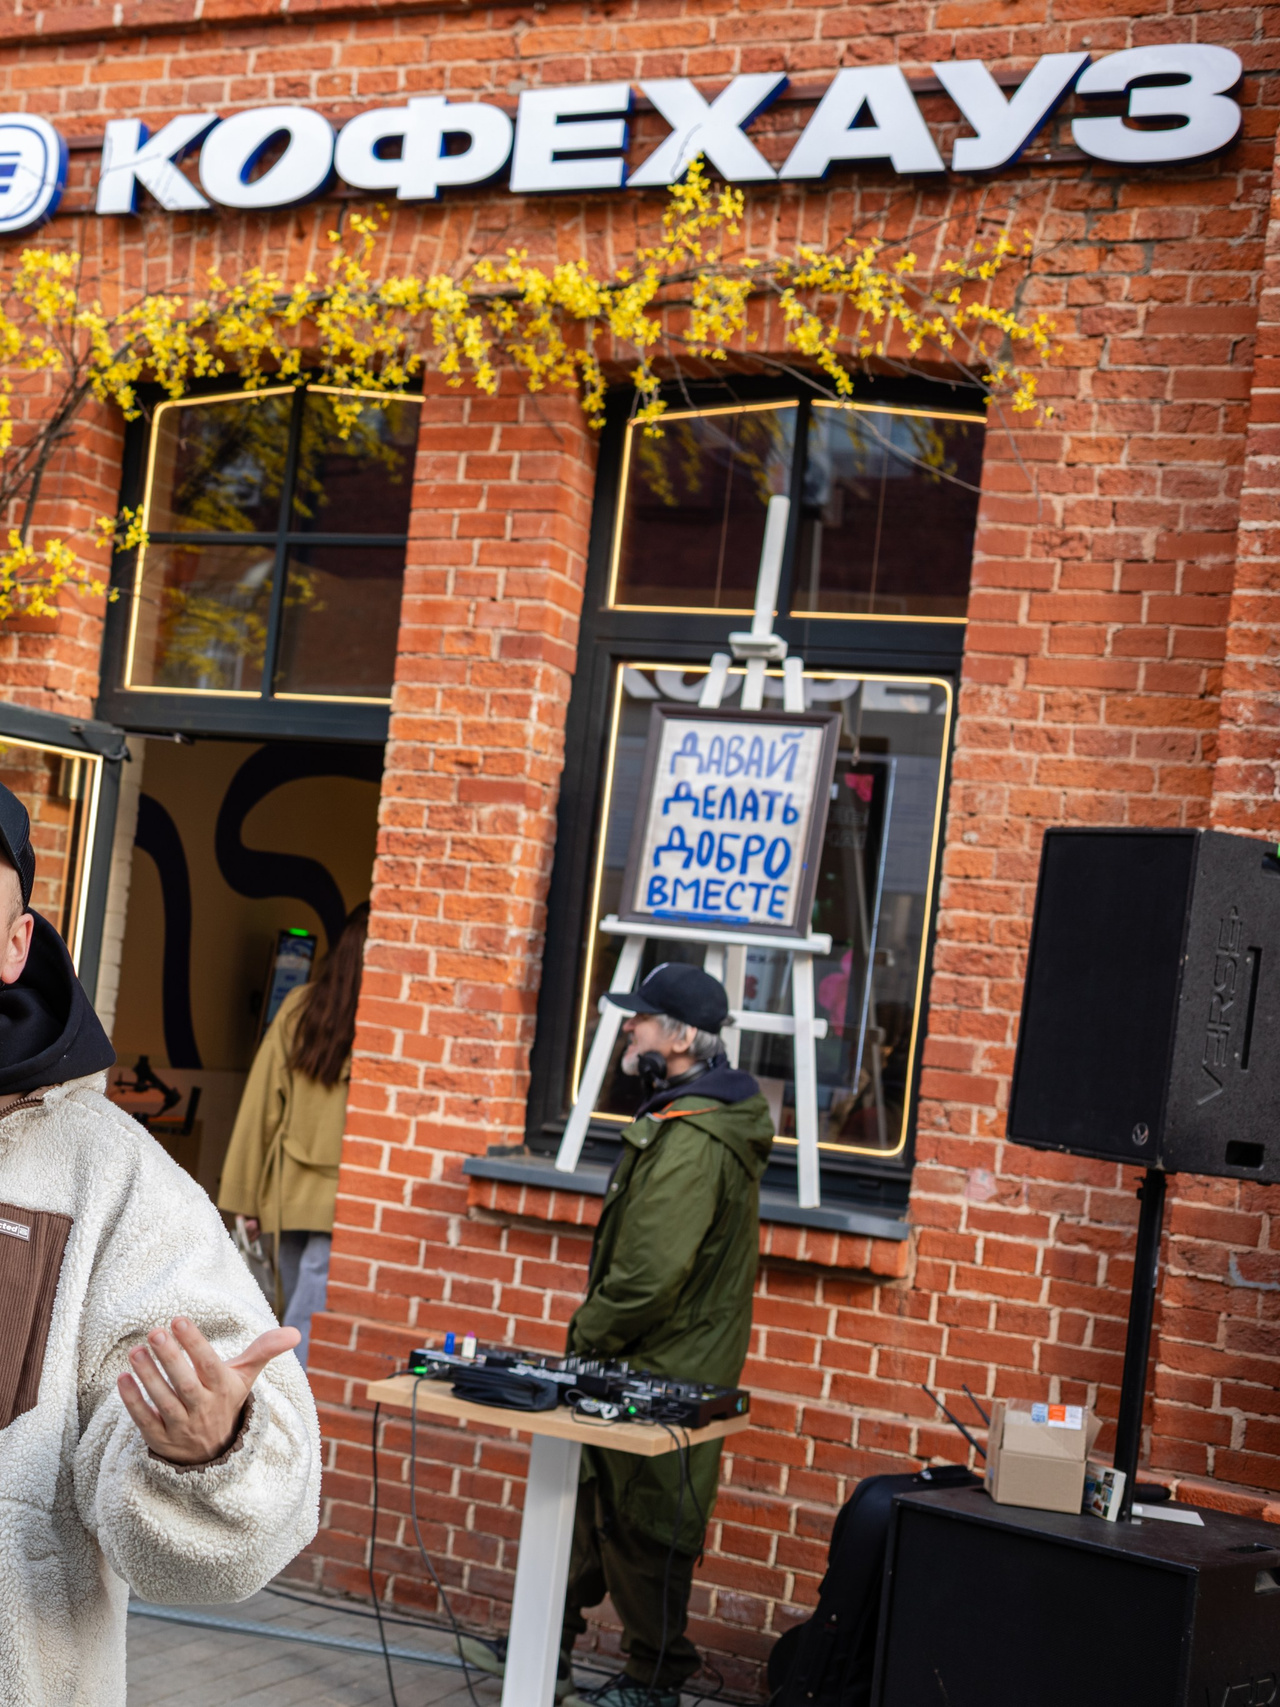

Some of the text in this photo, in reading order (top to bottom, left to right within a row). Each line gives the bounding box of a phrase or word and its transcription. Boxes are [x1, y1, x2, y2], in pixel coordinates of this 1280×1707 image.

[96, 44, 1244, 216] КОФЕХАУЗ
[670, 731, 805, 782] ДАВАЙ
[662, 781, 800, 825] ДЕЛАТЬ
[653, 825, 792, 880] ДОБРО
[646, 875, 789, 919] ВМЕСТЕ
